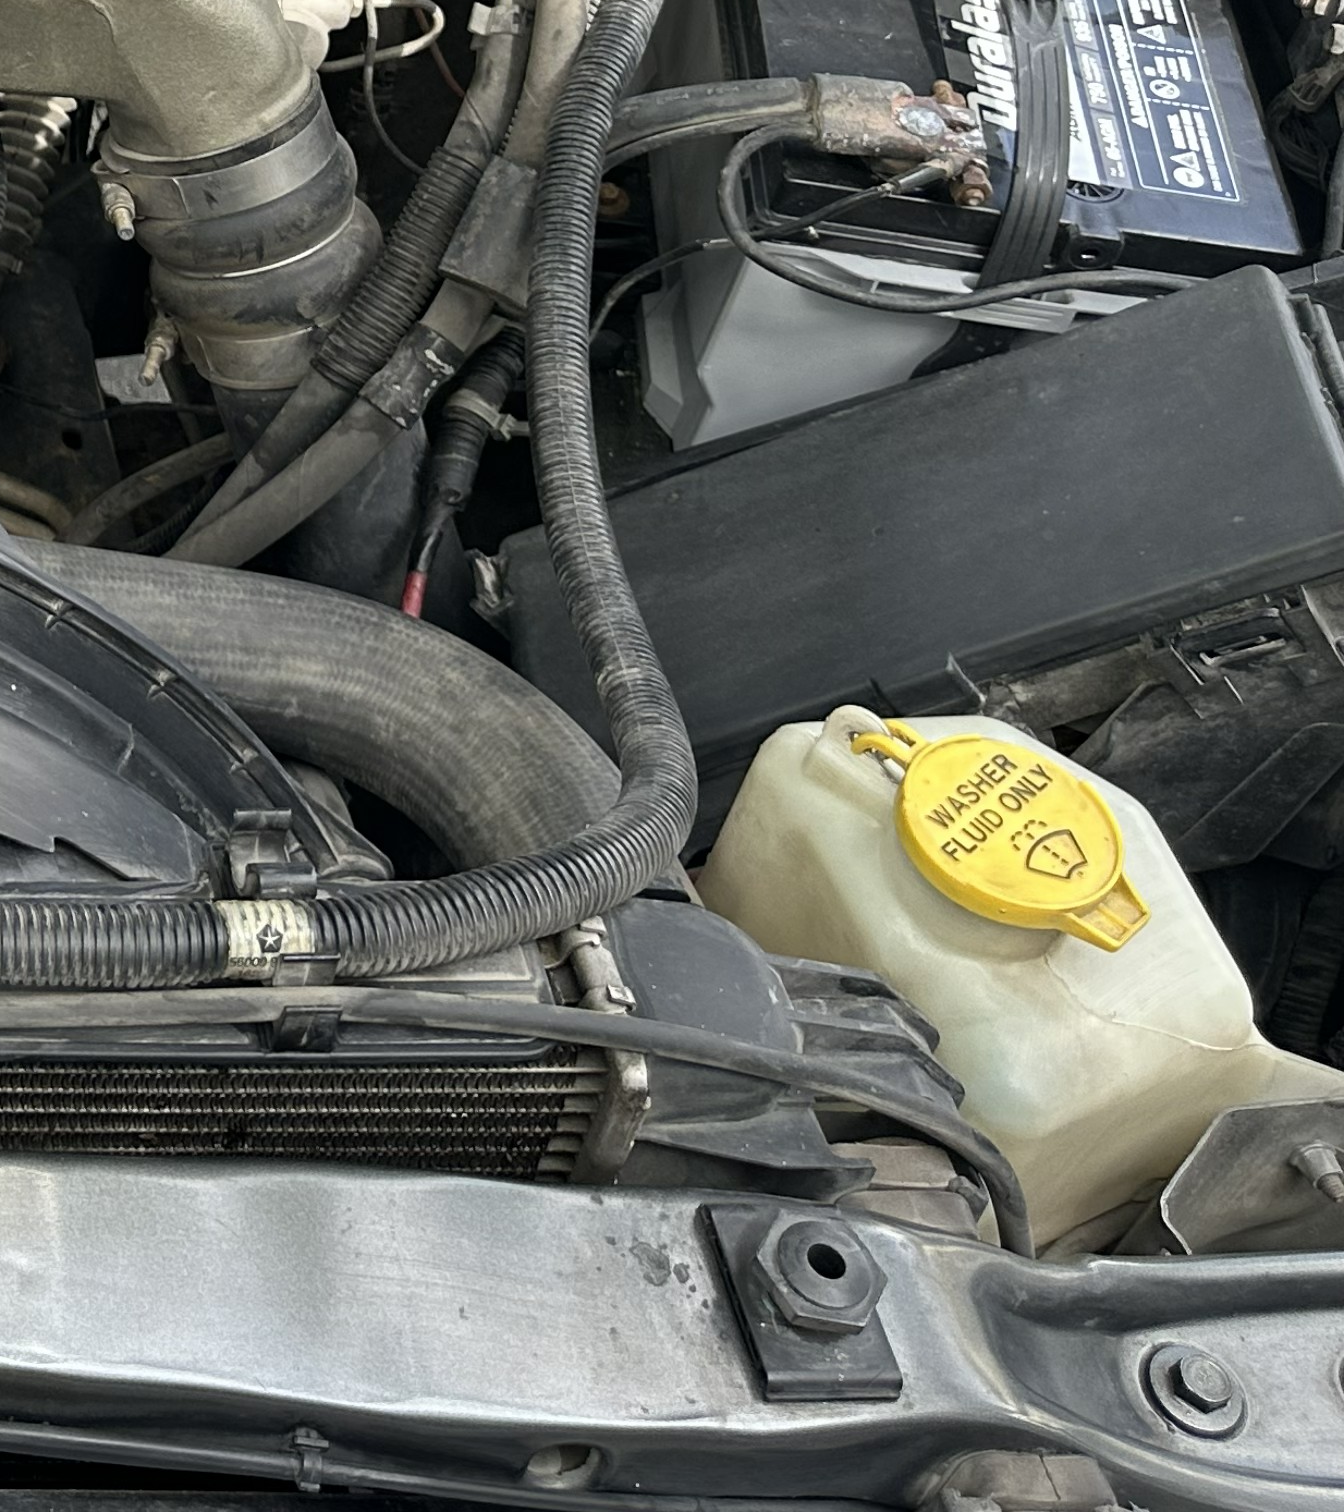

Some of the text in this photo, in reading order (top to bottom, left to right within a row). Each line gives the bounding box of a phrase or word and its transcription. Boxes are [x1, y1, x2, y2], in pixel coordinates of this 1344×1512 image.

[925, 753, 1018, 830] WASHER
[940, 764, 1054, 862] FLUID ONLY
